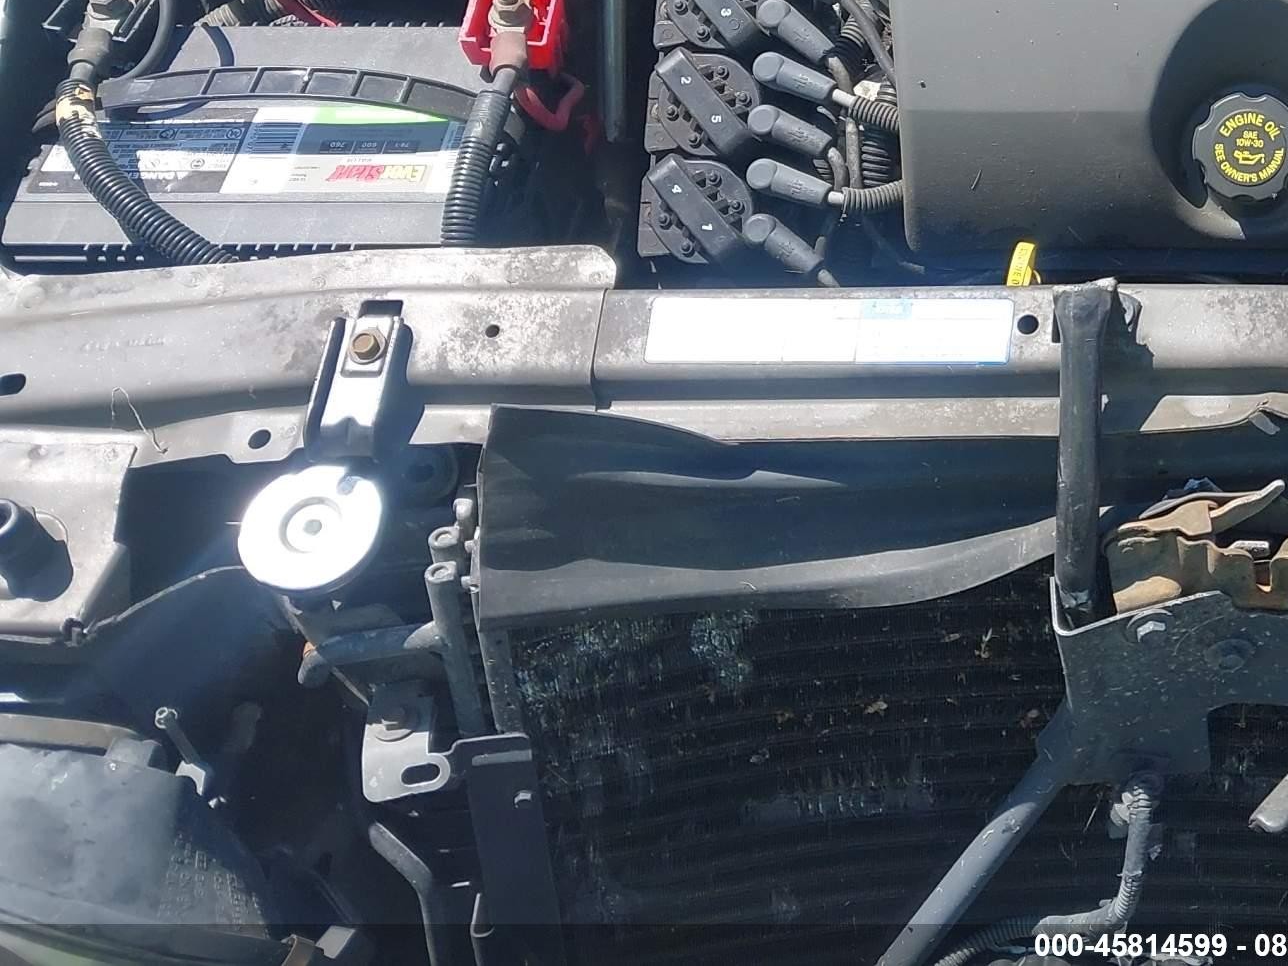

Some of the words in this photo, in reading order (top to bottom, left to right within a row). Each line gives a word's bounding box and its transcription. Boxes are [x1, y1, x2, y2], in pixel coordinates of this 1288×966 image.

[720, 8, 732, 17] 3
[681, 76, 692, 85] 2
[711, 115, 722, 124] 5
[1219, 113, 1265, 137] ENGINE
[1264, 122, 1281, 141] OIL
[1243, 130, 1258, 140] SAE
[1236, 139, 1264, 148] 10W-30
[1215, 144, 1226, 162] SEE
[1221, 161, 1258, 183] OWNER'S
[1259, 148, 1285, 180] MANUAL
[672, 185, 683, 194] 4
[701, 223, 713, 231] 1
